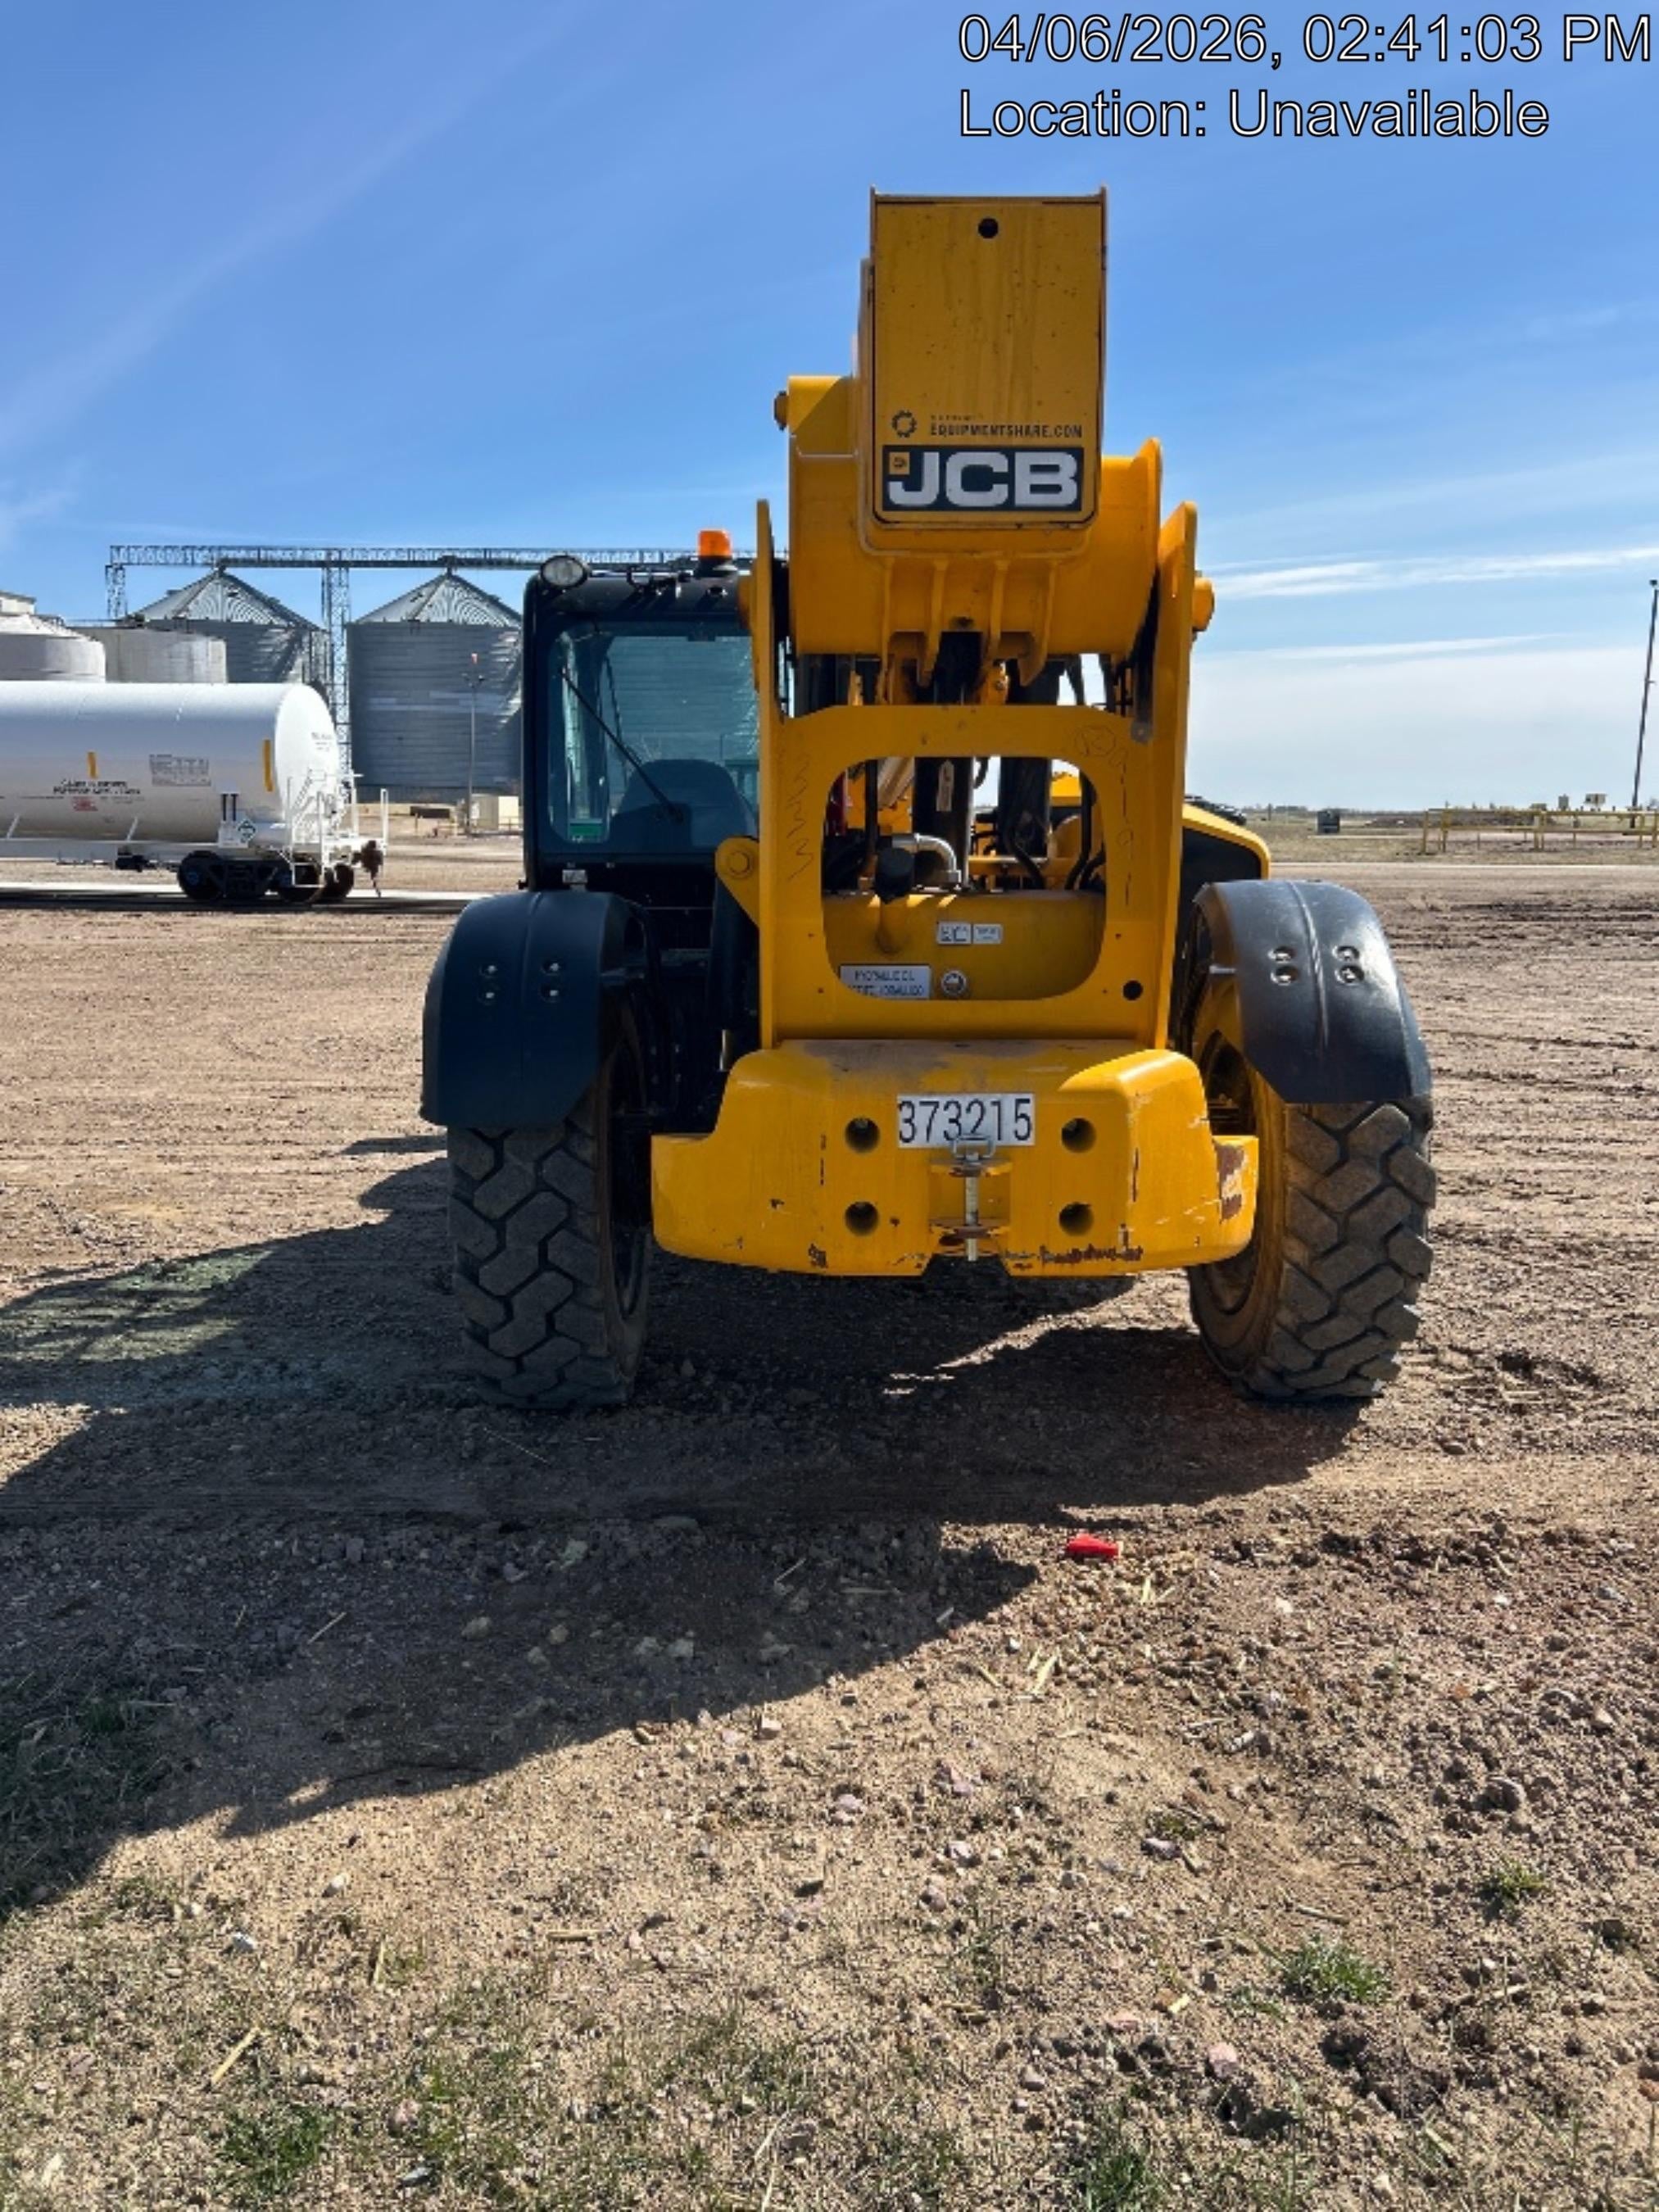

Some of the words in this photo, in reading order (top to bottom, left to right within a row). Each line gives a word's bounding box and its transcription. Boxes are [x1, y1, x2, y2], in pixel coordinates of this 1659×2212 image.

[931, 424, 1082, 438] EQUIPMENTSHARE.COM
[888, 451, 1078, 507] JCB
[899, 1098, 1031, 1143] 373215
